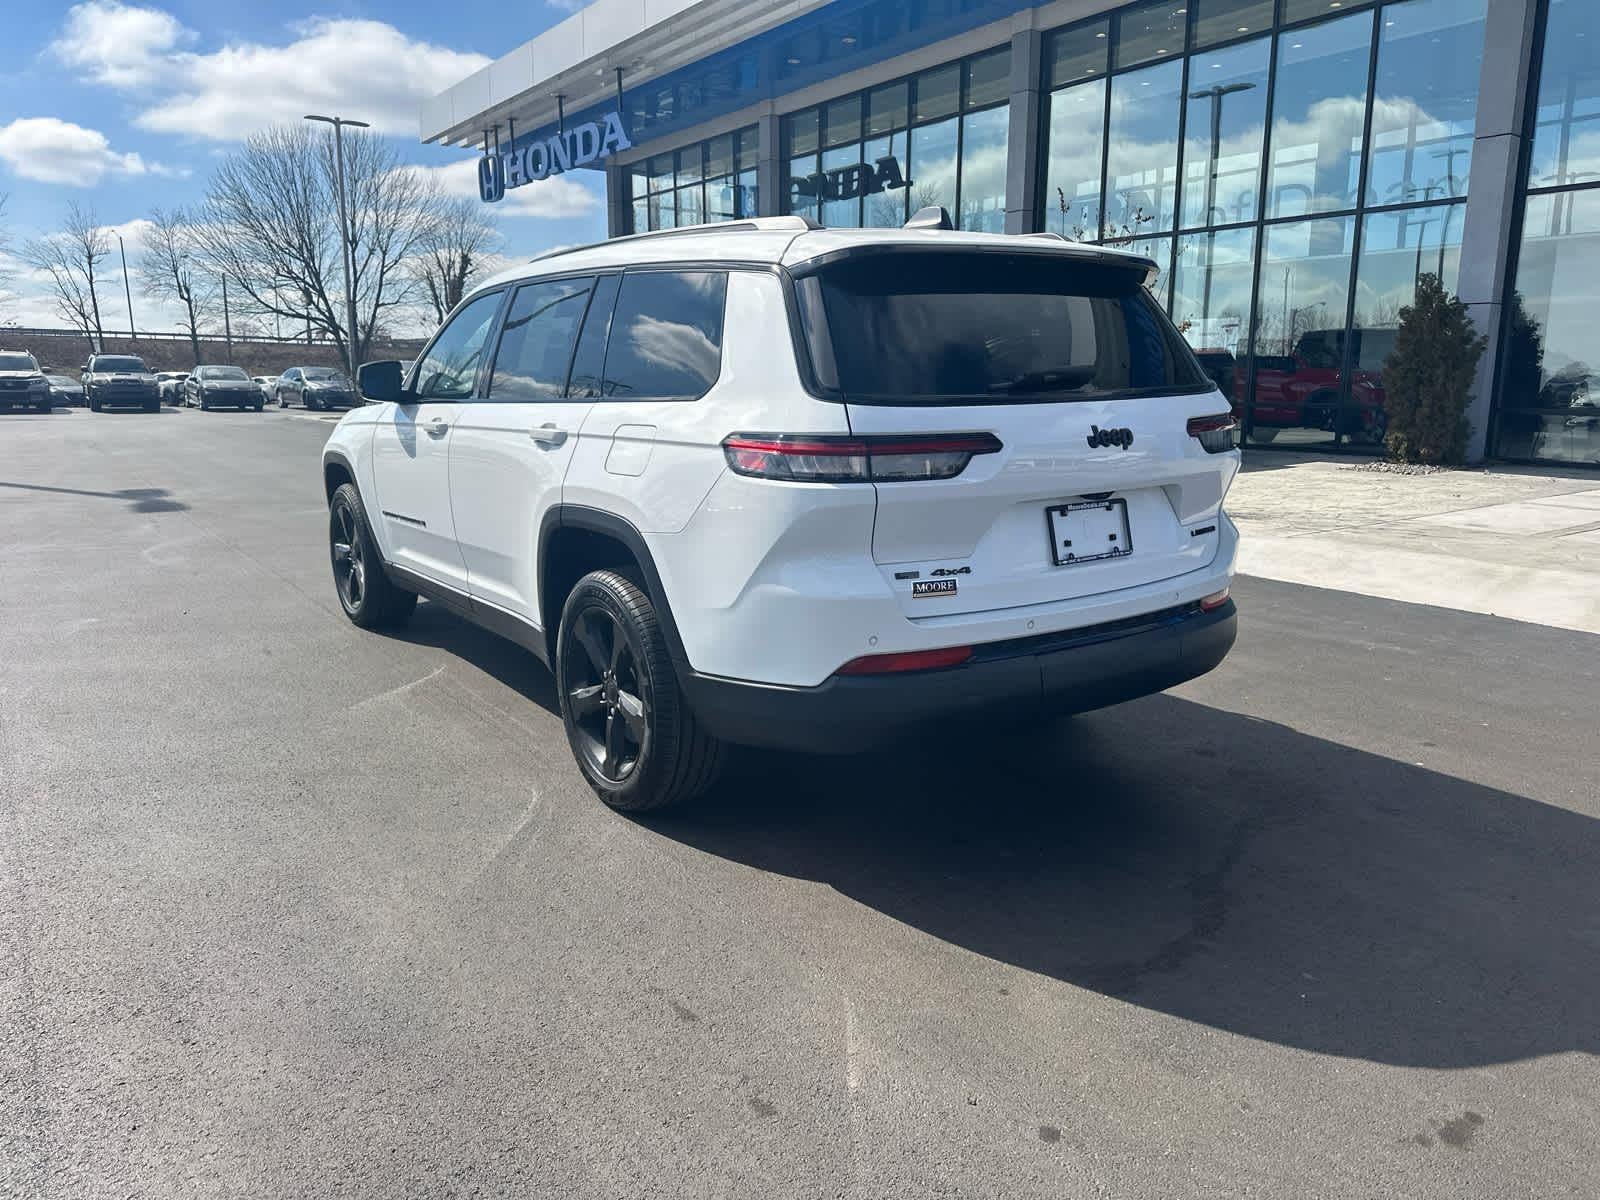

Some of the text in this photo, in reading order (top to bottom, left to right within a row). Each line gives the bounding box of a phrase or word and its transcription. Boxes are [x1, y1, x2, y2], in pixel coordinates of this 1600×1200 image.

[504, 112, 631, 189] HONDA
[1086, 424, 1134, 451] Jeep
[930, 565, 972, 577] 4x4
[915, 580, 955, 593] MOORE
